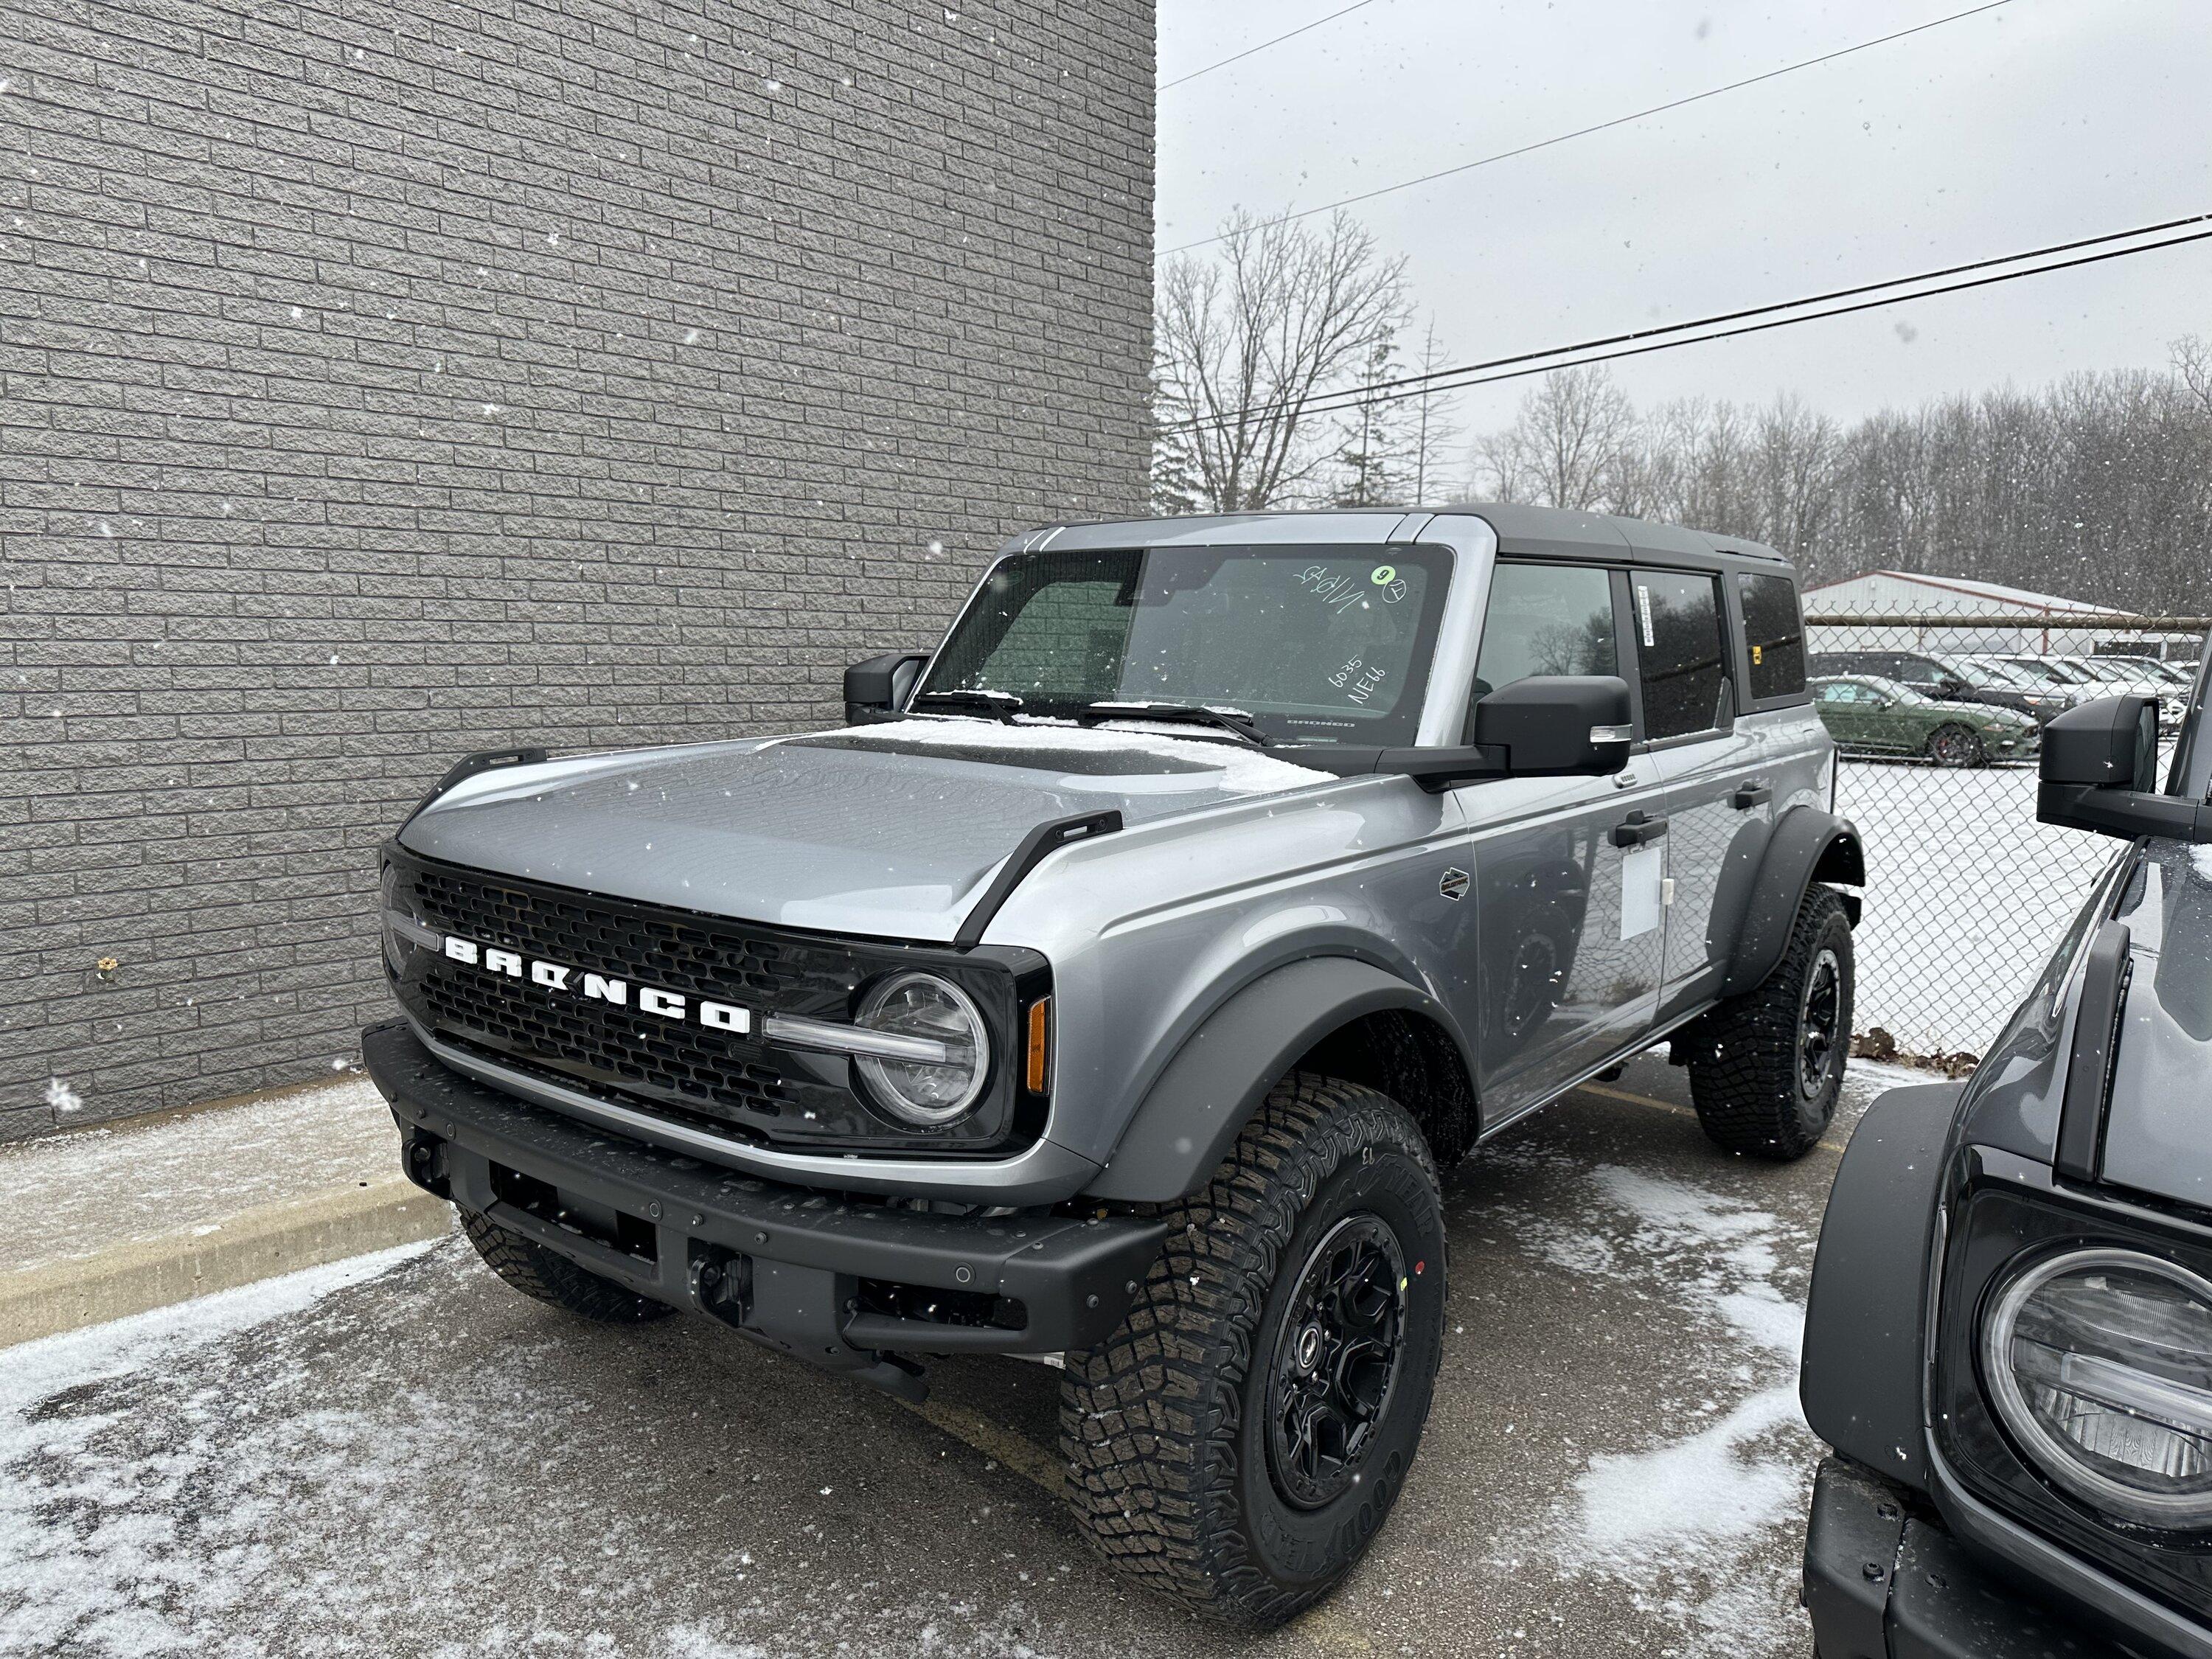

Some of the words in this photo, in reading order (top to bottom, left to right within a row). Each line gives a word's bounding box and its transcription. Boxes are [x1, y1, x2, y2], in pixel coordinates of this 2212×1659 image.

[1328, 654, 1363, 688] 6035
[1347, 667, 1385, 704] NE66
[445, 936, 751, 1034] BRONCO
